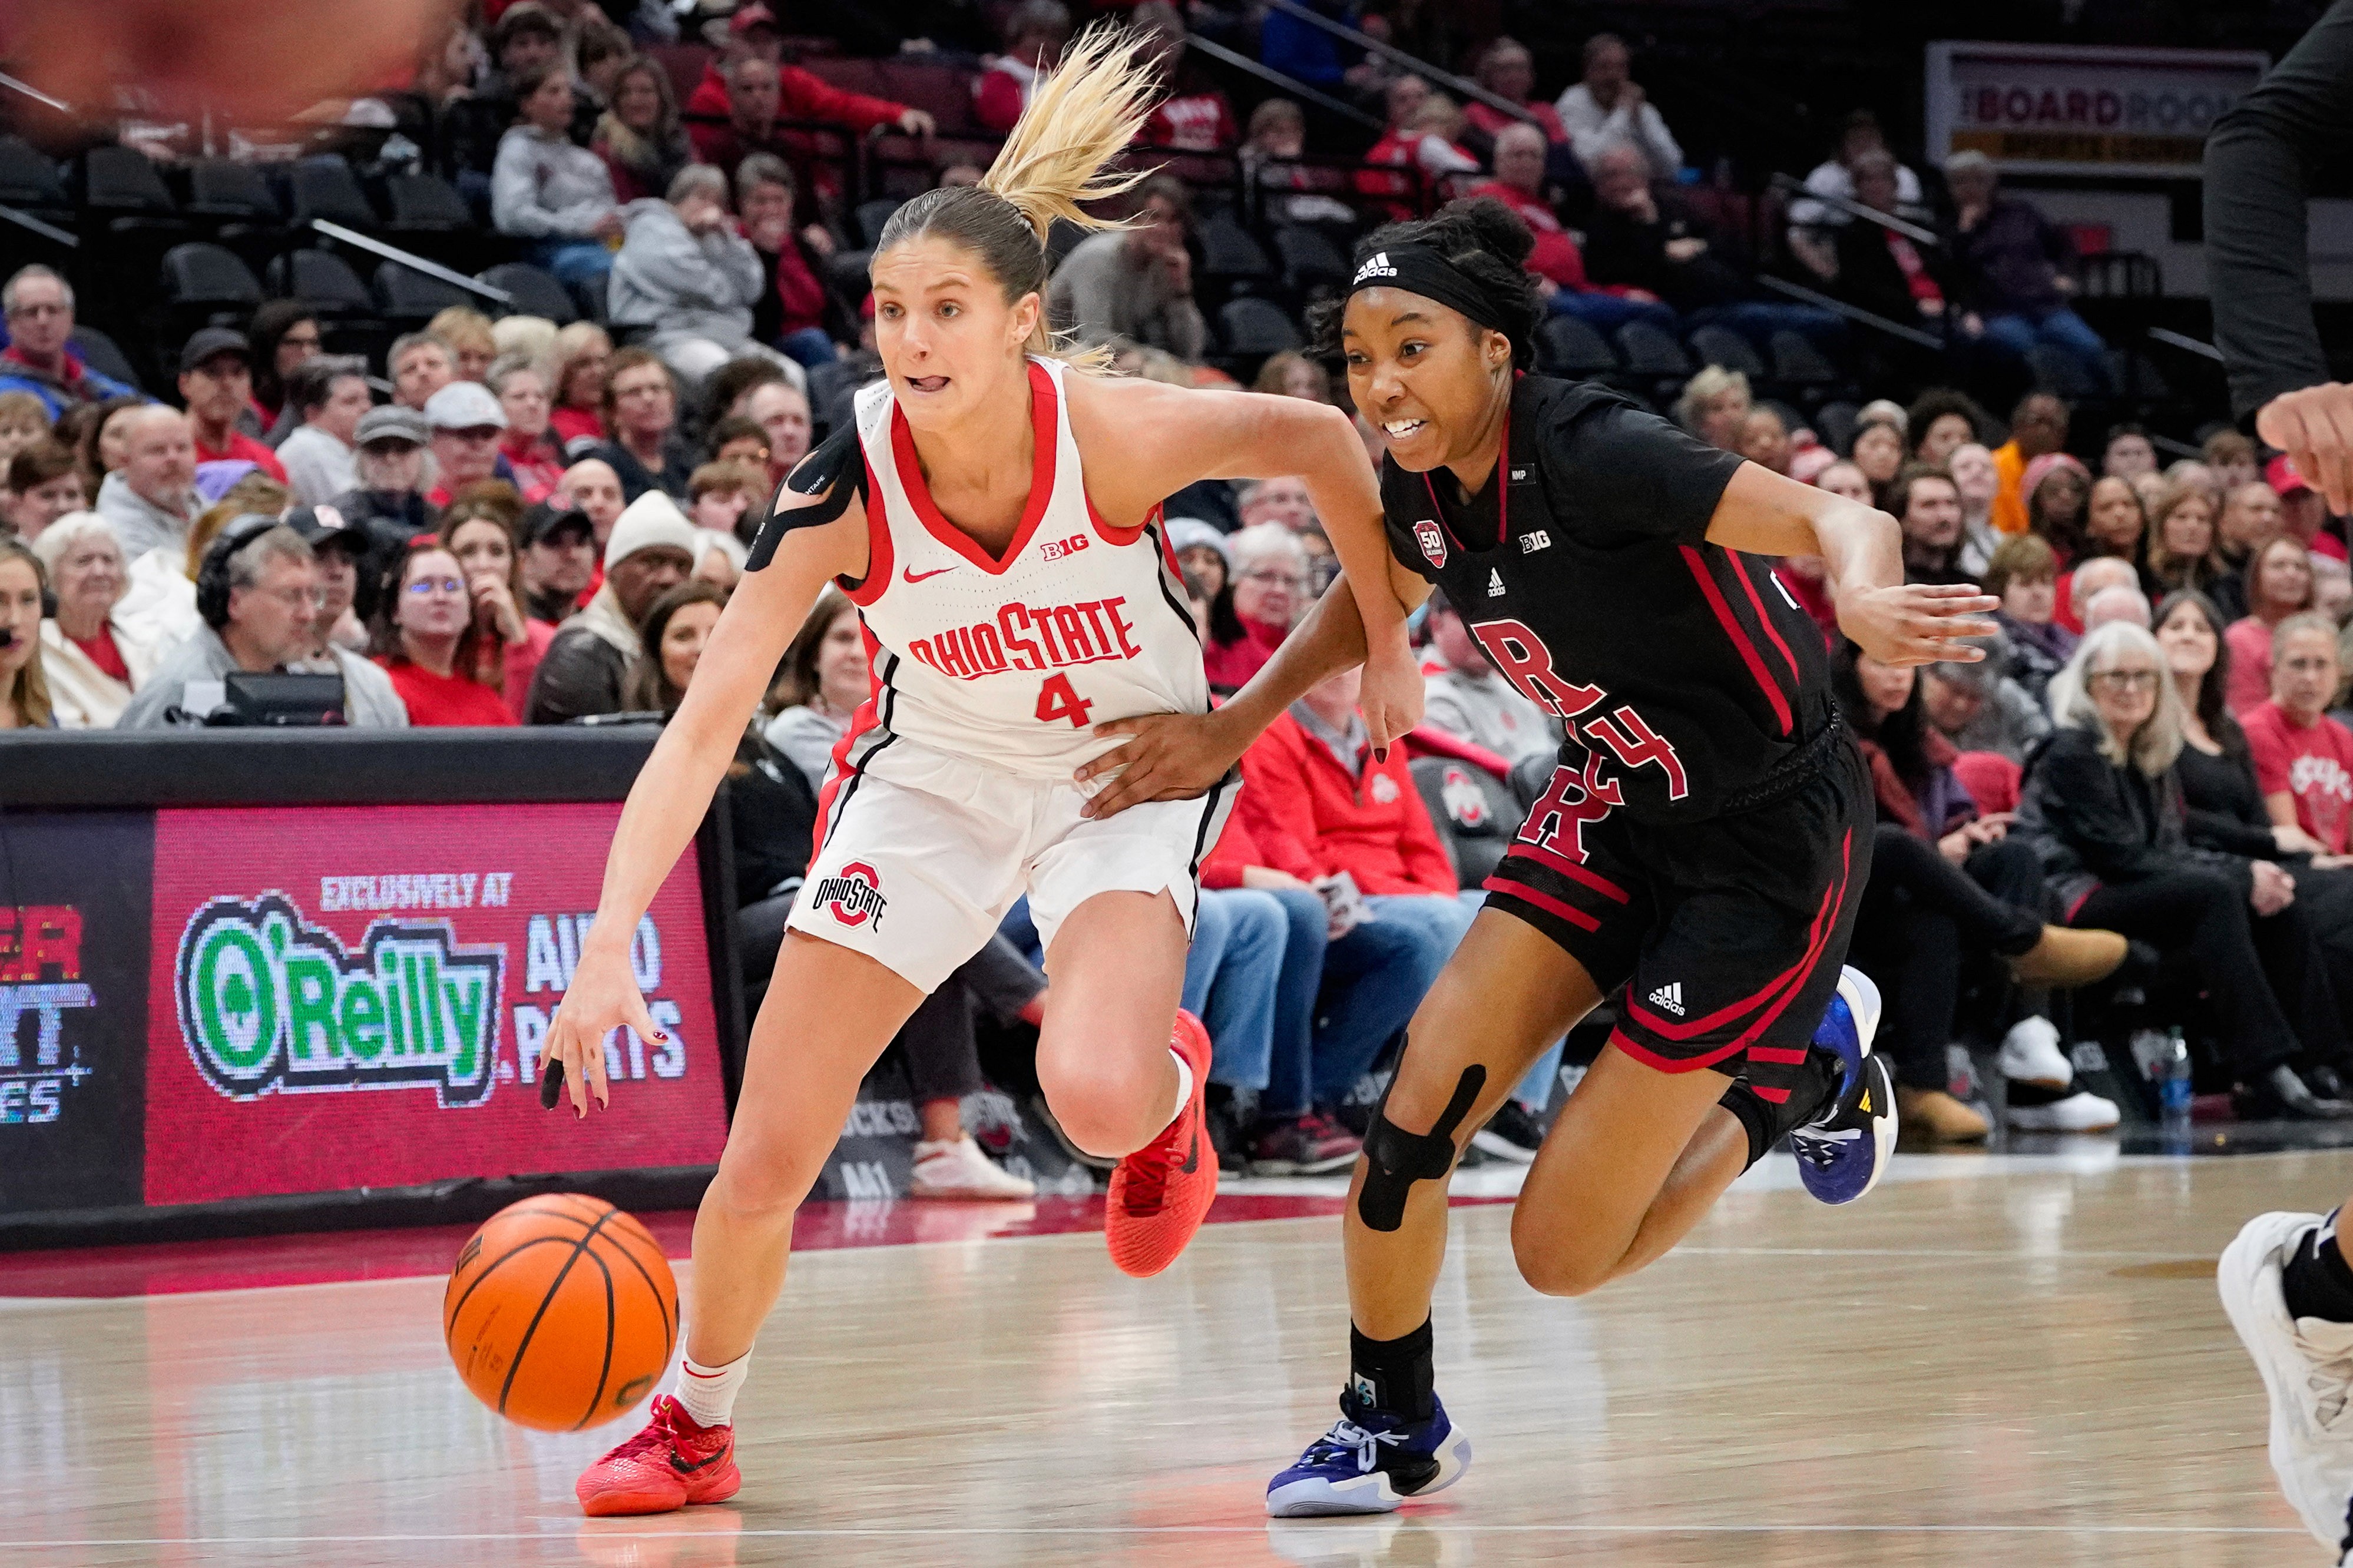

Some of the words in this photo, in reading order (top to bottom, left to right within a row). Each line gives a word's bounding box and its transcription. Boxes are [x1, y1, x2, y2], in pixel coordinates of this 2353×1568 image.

[1978, 87, 2232, 128] BOARDROO
[1353, 266, 1398, 286] adidas
[1419, 531, 1441, 549] 50
[1470, 619, 1608, 718] R
[1035, 671, 1094, 728] 4
[1517, 764, 1613, 864] R
[320, 873, 478, 911] EXCLUSIVELY
[481, 872, 514, 907] AT
[526, 912, 661, 992] AUO
[192, 909, 490, 1085] O'Reilly
[1649, 992, 1686, 1016] adidas
